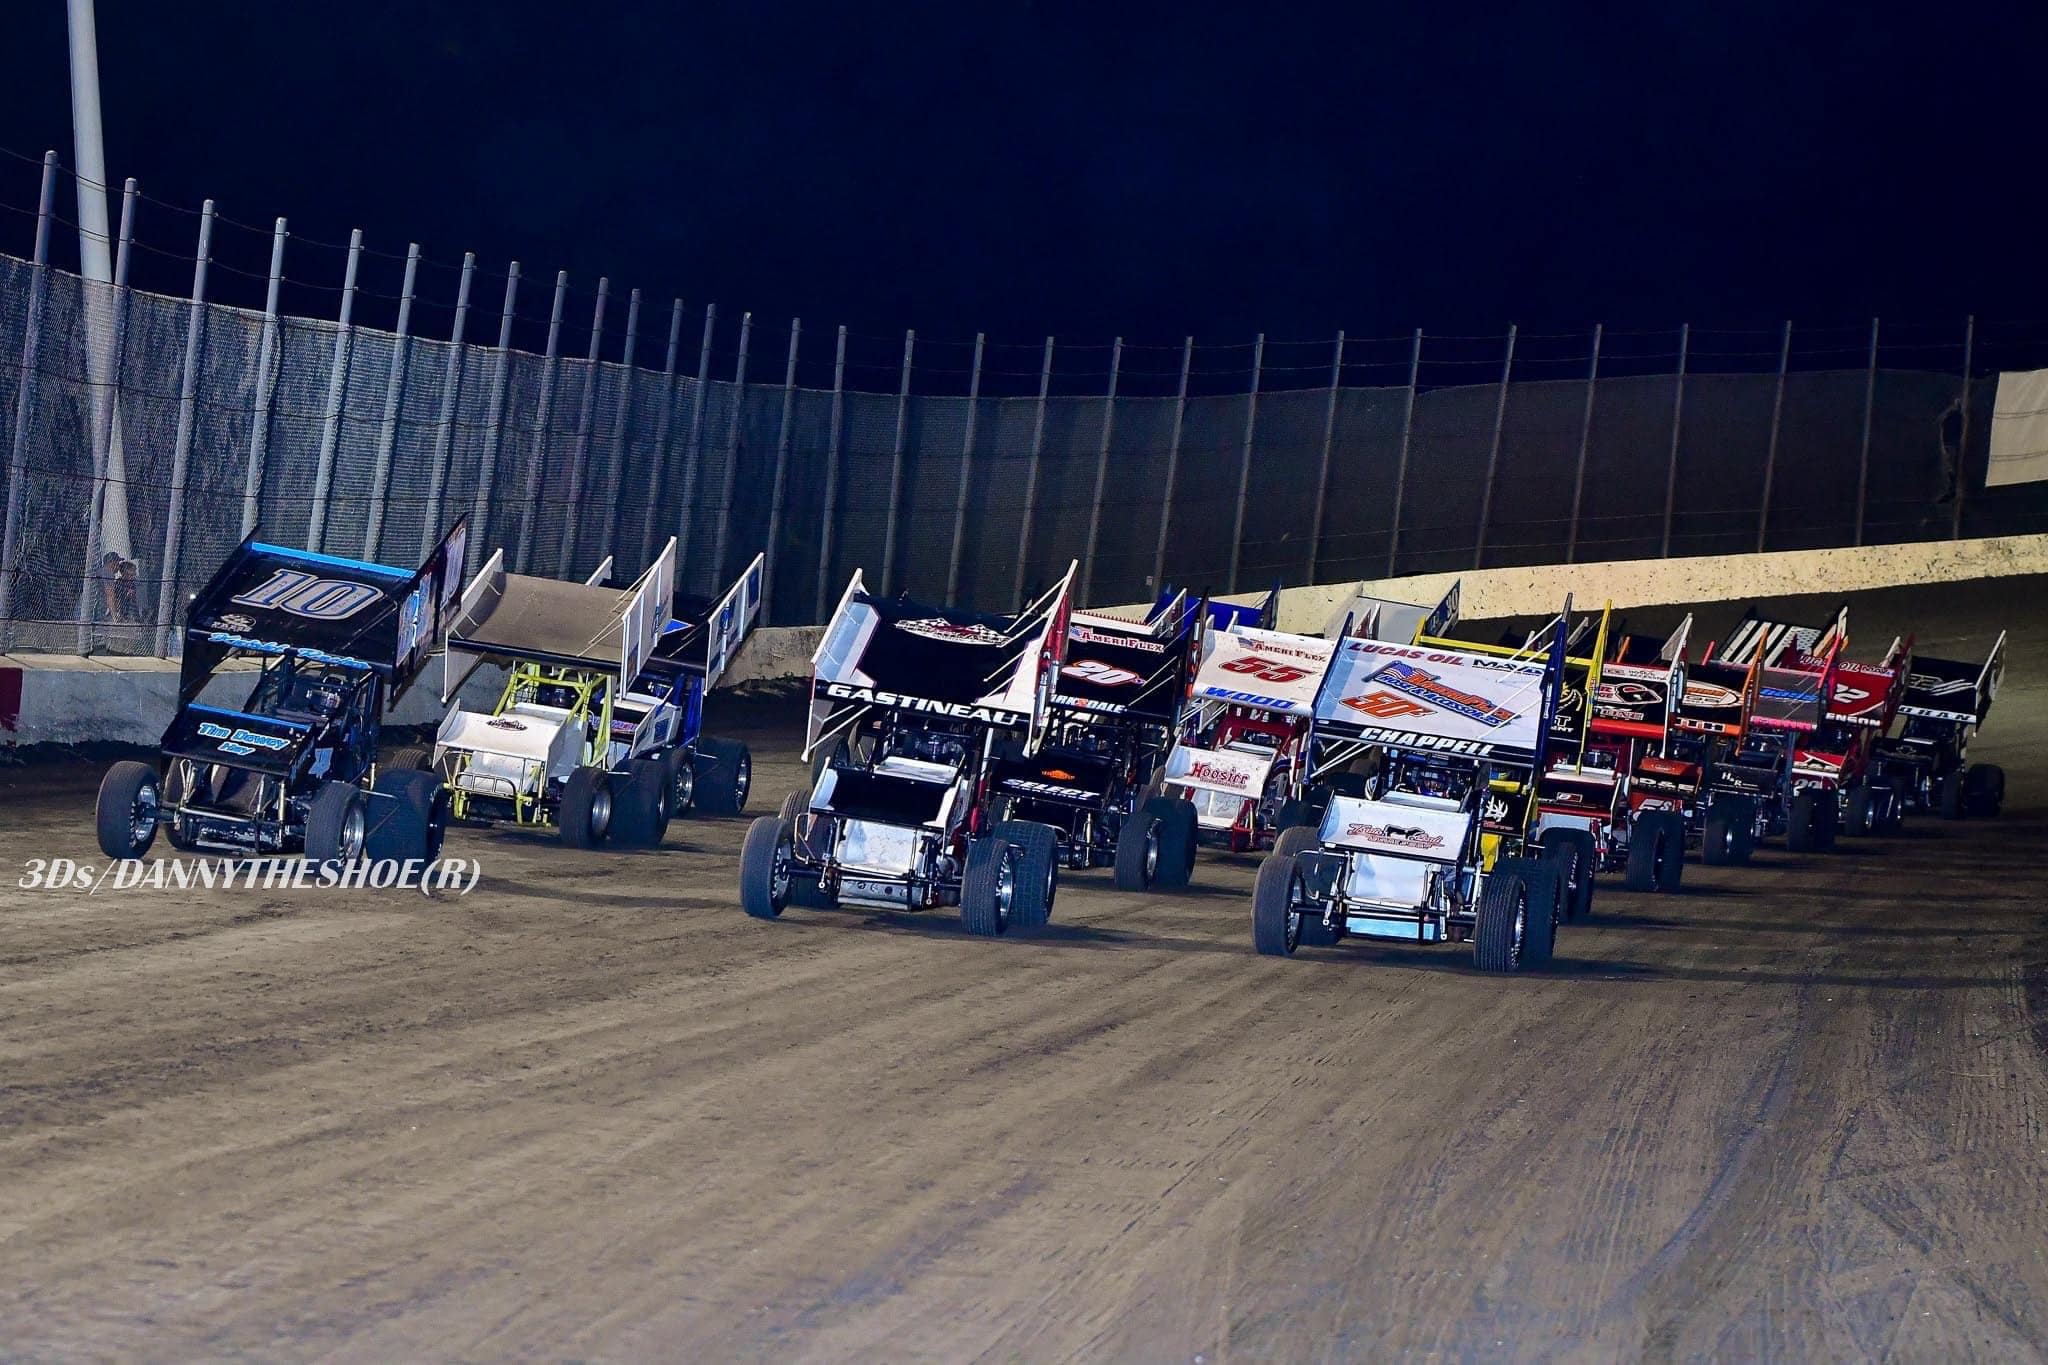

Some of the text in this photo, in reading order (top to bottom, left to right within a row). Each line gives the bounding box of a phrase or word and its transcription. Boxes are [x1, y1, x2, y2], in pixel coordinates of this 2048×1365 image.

[231, 569, 384, 620] 10
[1348, 642, 1425, 659] LUCAS
[1427, 654, 1464, 667] OIL
[1060, 660, 1138, 686] 20
[1218, 656, 1316, 683] 55
[827, 683, 1020, 726] GASTINEAU
[1202, 686, 1299, 709] WOOD
[1358, 727, 1496, 757] CHAPPELL
[1184, 761, 1250, 785] Hoosier
[1002, 778, 1100, 797] SELECT
